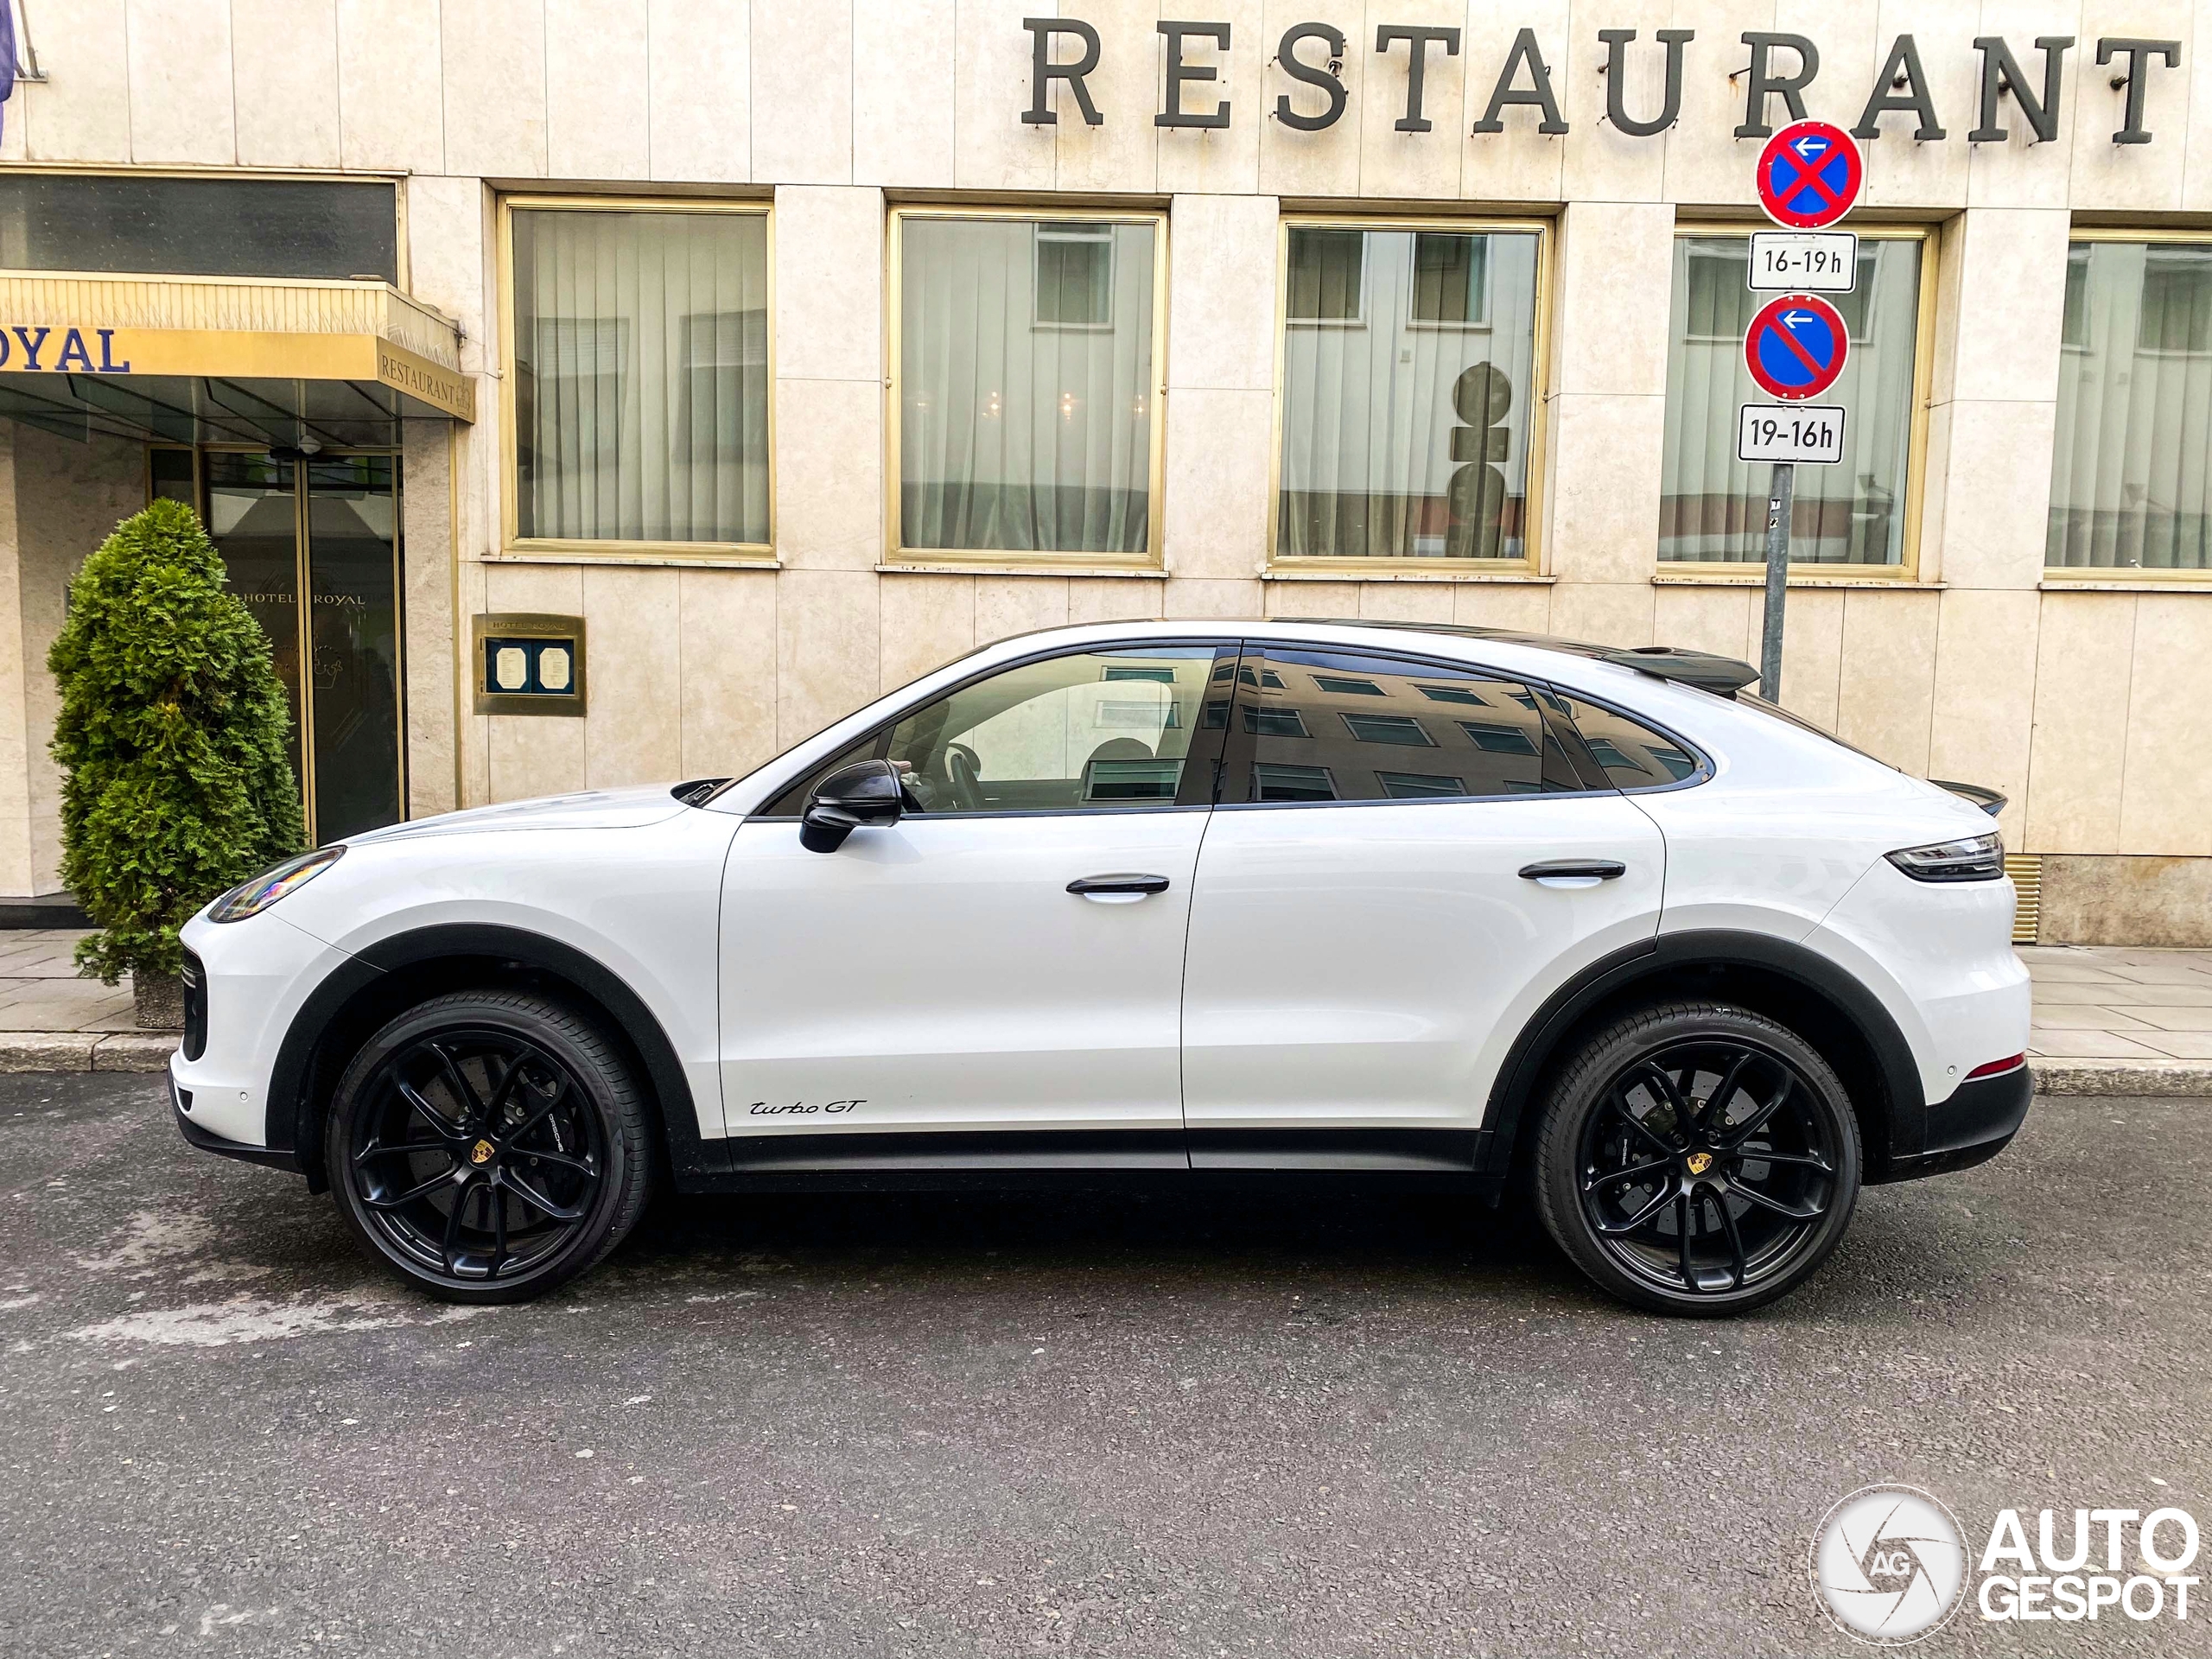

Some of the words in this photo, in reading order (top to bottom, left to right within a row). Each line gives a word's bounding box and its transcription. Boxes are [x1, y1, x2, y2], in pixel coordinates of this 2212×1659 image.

[1021, 17, 2182, 144] RESTAURANT
[0, 326, 130, 372] YAL
[382, 354, 454, 404] RESTAURANT
[244, 593, 296, 603] HOTEL
[314, 594, 366, 606] ROYAL
[531, 622, 567, 631] ROYAL
[749, 1102, 819, 1115] turbo
[824, 1100, 868, 1113] GT
[548, 1113, 564, 1153] ORSCHE
